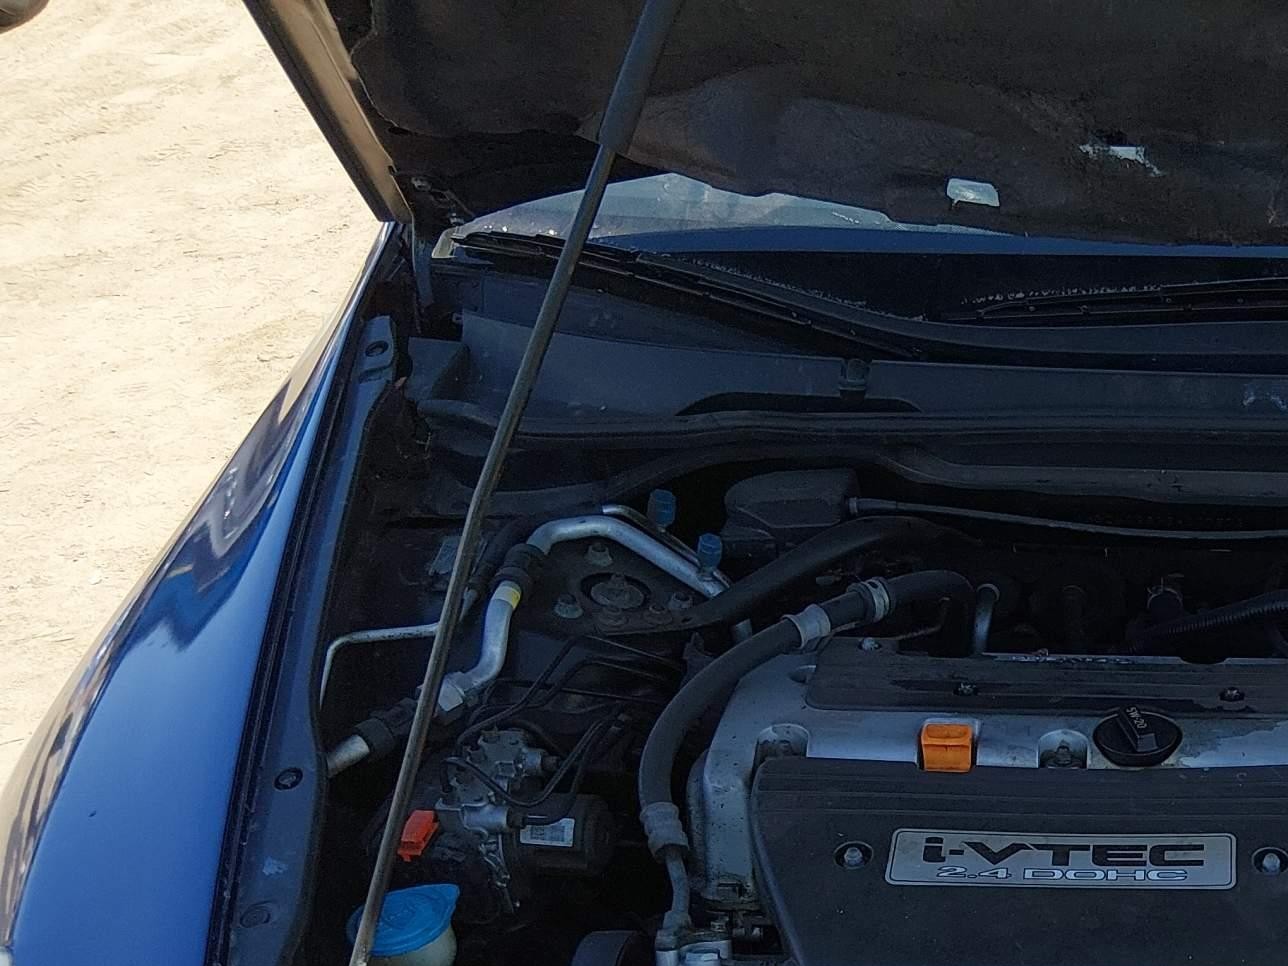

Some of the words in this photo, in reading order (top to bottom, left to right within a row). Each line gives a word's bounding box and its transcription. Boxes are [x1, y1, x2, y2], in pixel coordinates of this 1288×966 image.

[1125, 705, 1149, 729] 5W-20
[922, 835, 1206, 867] i-VTEC
[936, 865, 1014, 880] 2.4
[1022, 867, 1189, 882] DOHC
